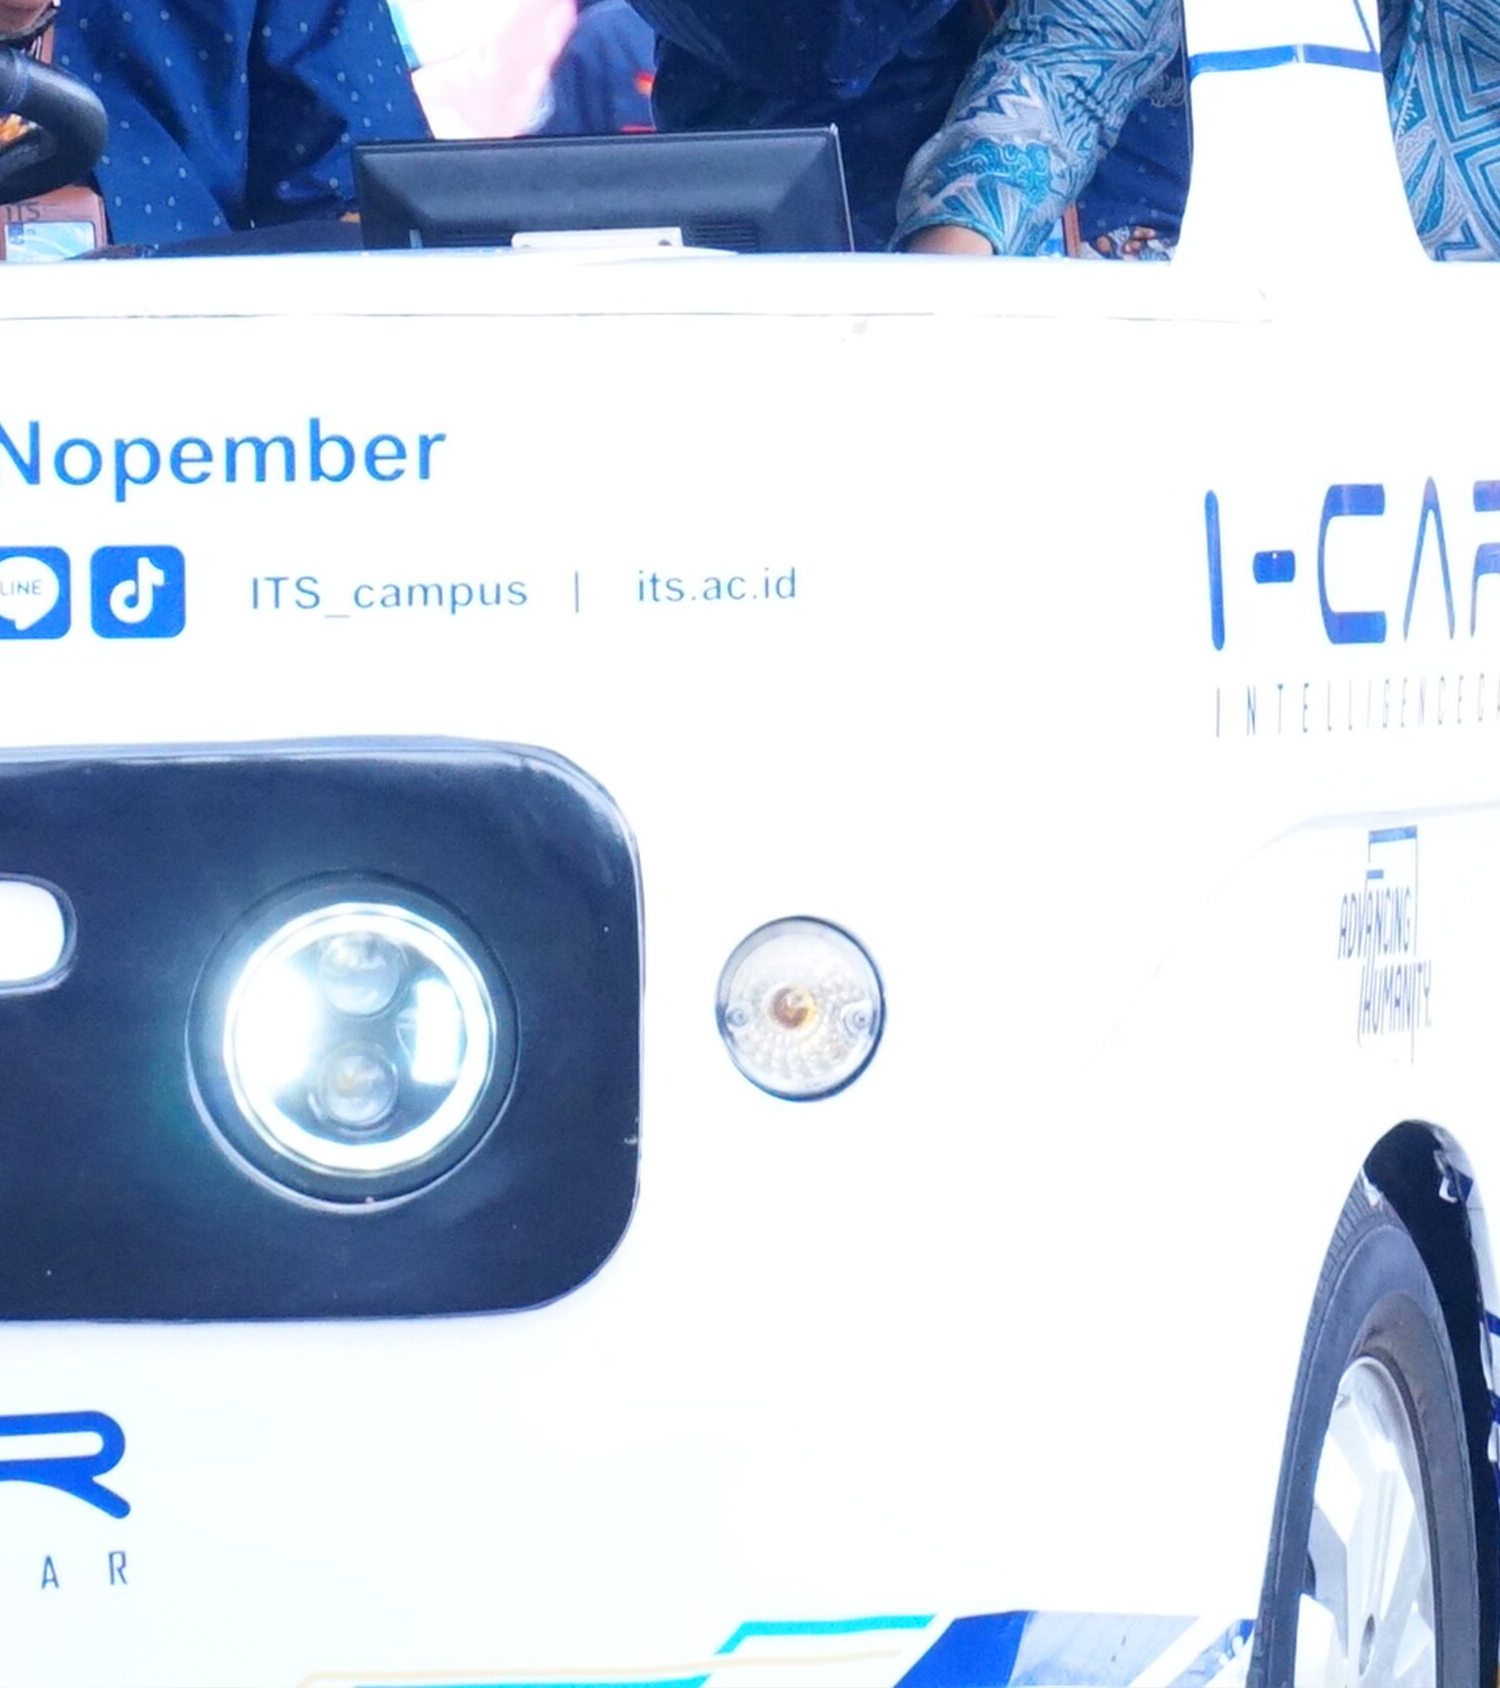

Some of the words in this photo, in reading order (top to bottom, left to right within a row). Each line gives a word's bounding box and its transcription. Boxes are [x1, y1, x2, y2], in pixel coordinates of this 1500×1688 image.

[0, 580, 43, 596] LINE
[252, 572, 529, 618] ITS_campus
[636, 564, 797, 603] its.ac.id
[1338, 885, 1411, 960] ADVANCING
